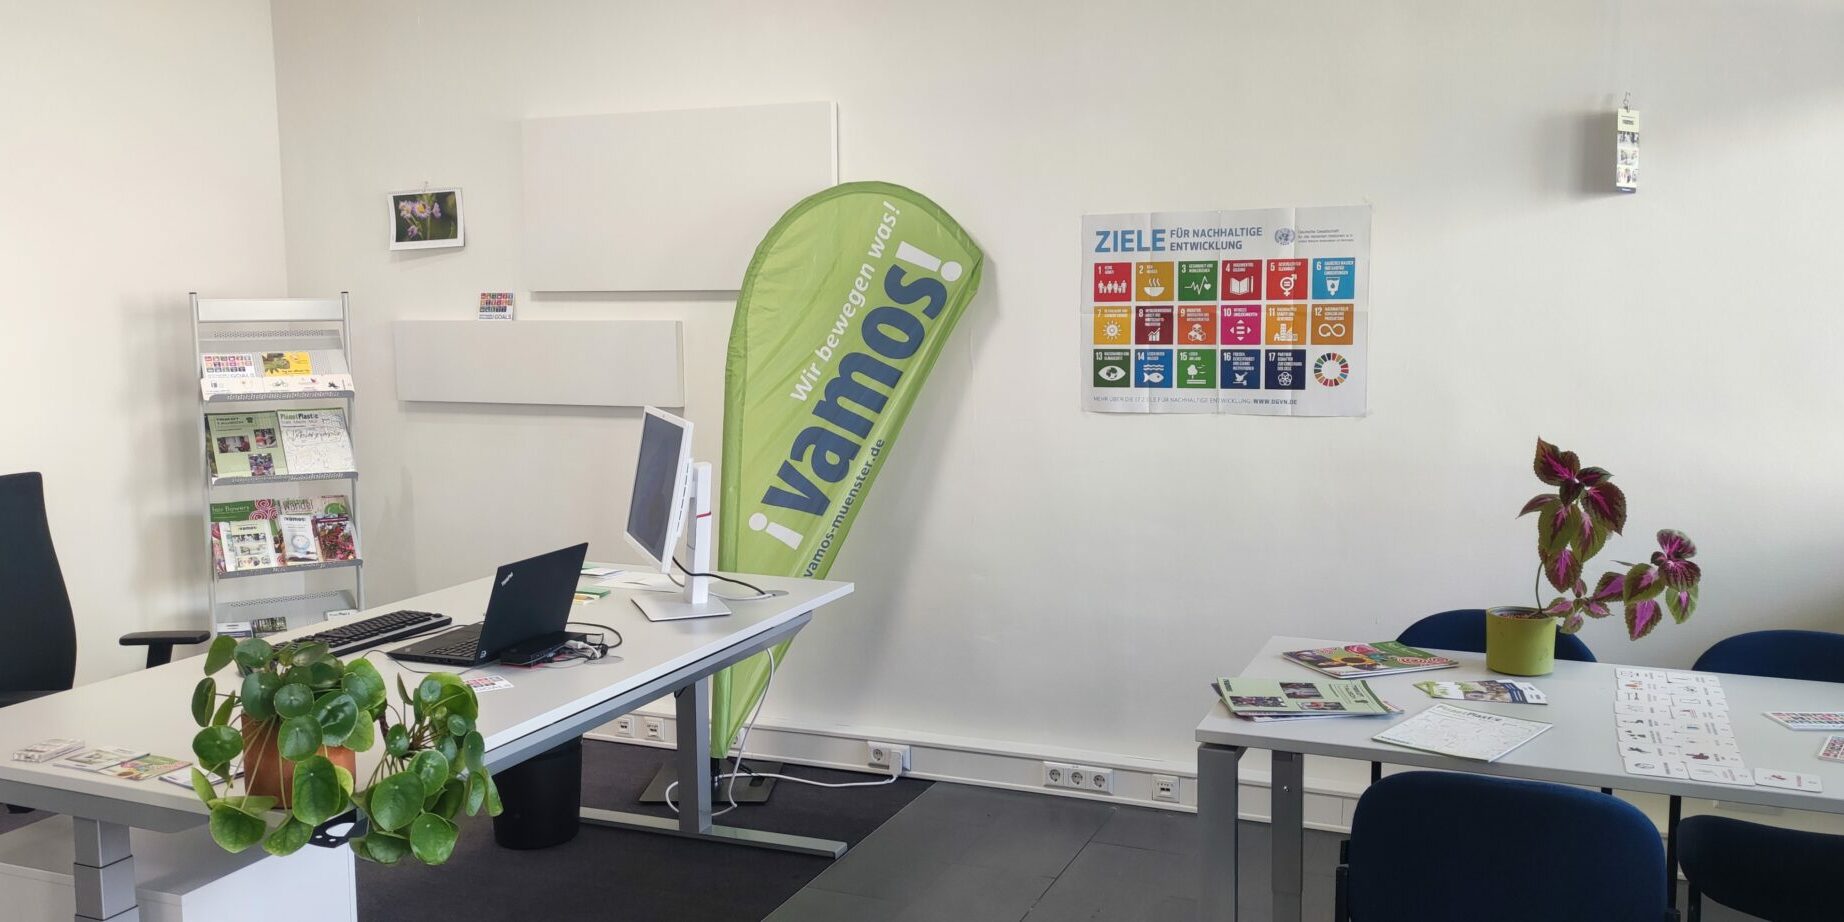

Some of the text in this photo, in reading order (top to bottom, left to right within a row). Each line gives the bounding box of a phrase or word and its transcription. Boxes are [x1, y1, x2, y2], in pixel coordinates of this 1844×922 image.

[1095, 227, 1262, 253] ZIELE FÜR NACHHALTIGE
[1170, 240, 1243, 251] ENTWICKLUNG
[1098, 266, 1102, 275] 1
[1139, 266, 1144, 274] 2
[1181, 264, 1187, 273] 3
[1225, 263, 1231, 273] 4
[1270, 262, 1276, 272] 5
[1316, 261, 1322, 271] 6
[790, 201, 901, 402] Wir bewegen was!
[1097, 309, 1102, 318] 7
[1138, 308, 1144, 317] 8
[1180, 308, 1186, 317] 9
[1223, 307, 1232, 317] 10
[1268, 307, 1276, 317] 11
[1314, 307, 1323, 317] 12
[1095, 351, 1103, 361] 13
[1137, 351, 1145, 361] 14
[1180, 351, 1188, 361] 15
[1223, 352, 1232, 362] 16
[1268, 352, 1276, 362] 17
[803, 438, 886, 579] vamos-muenster.de
